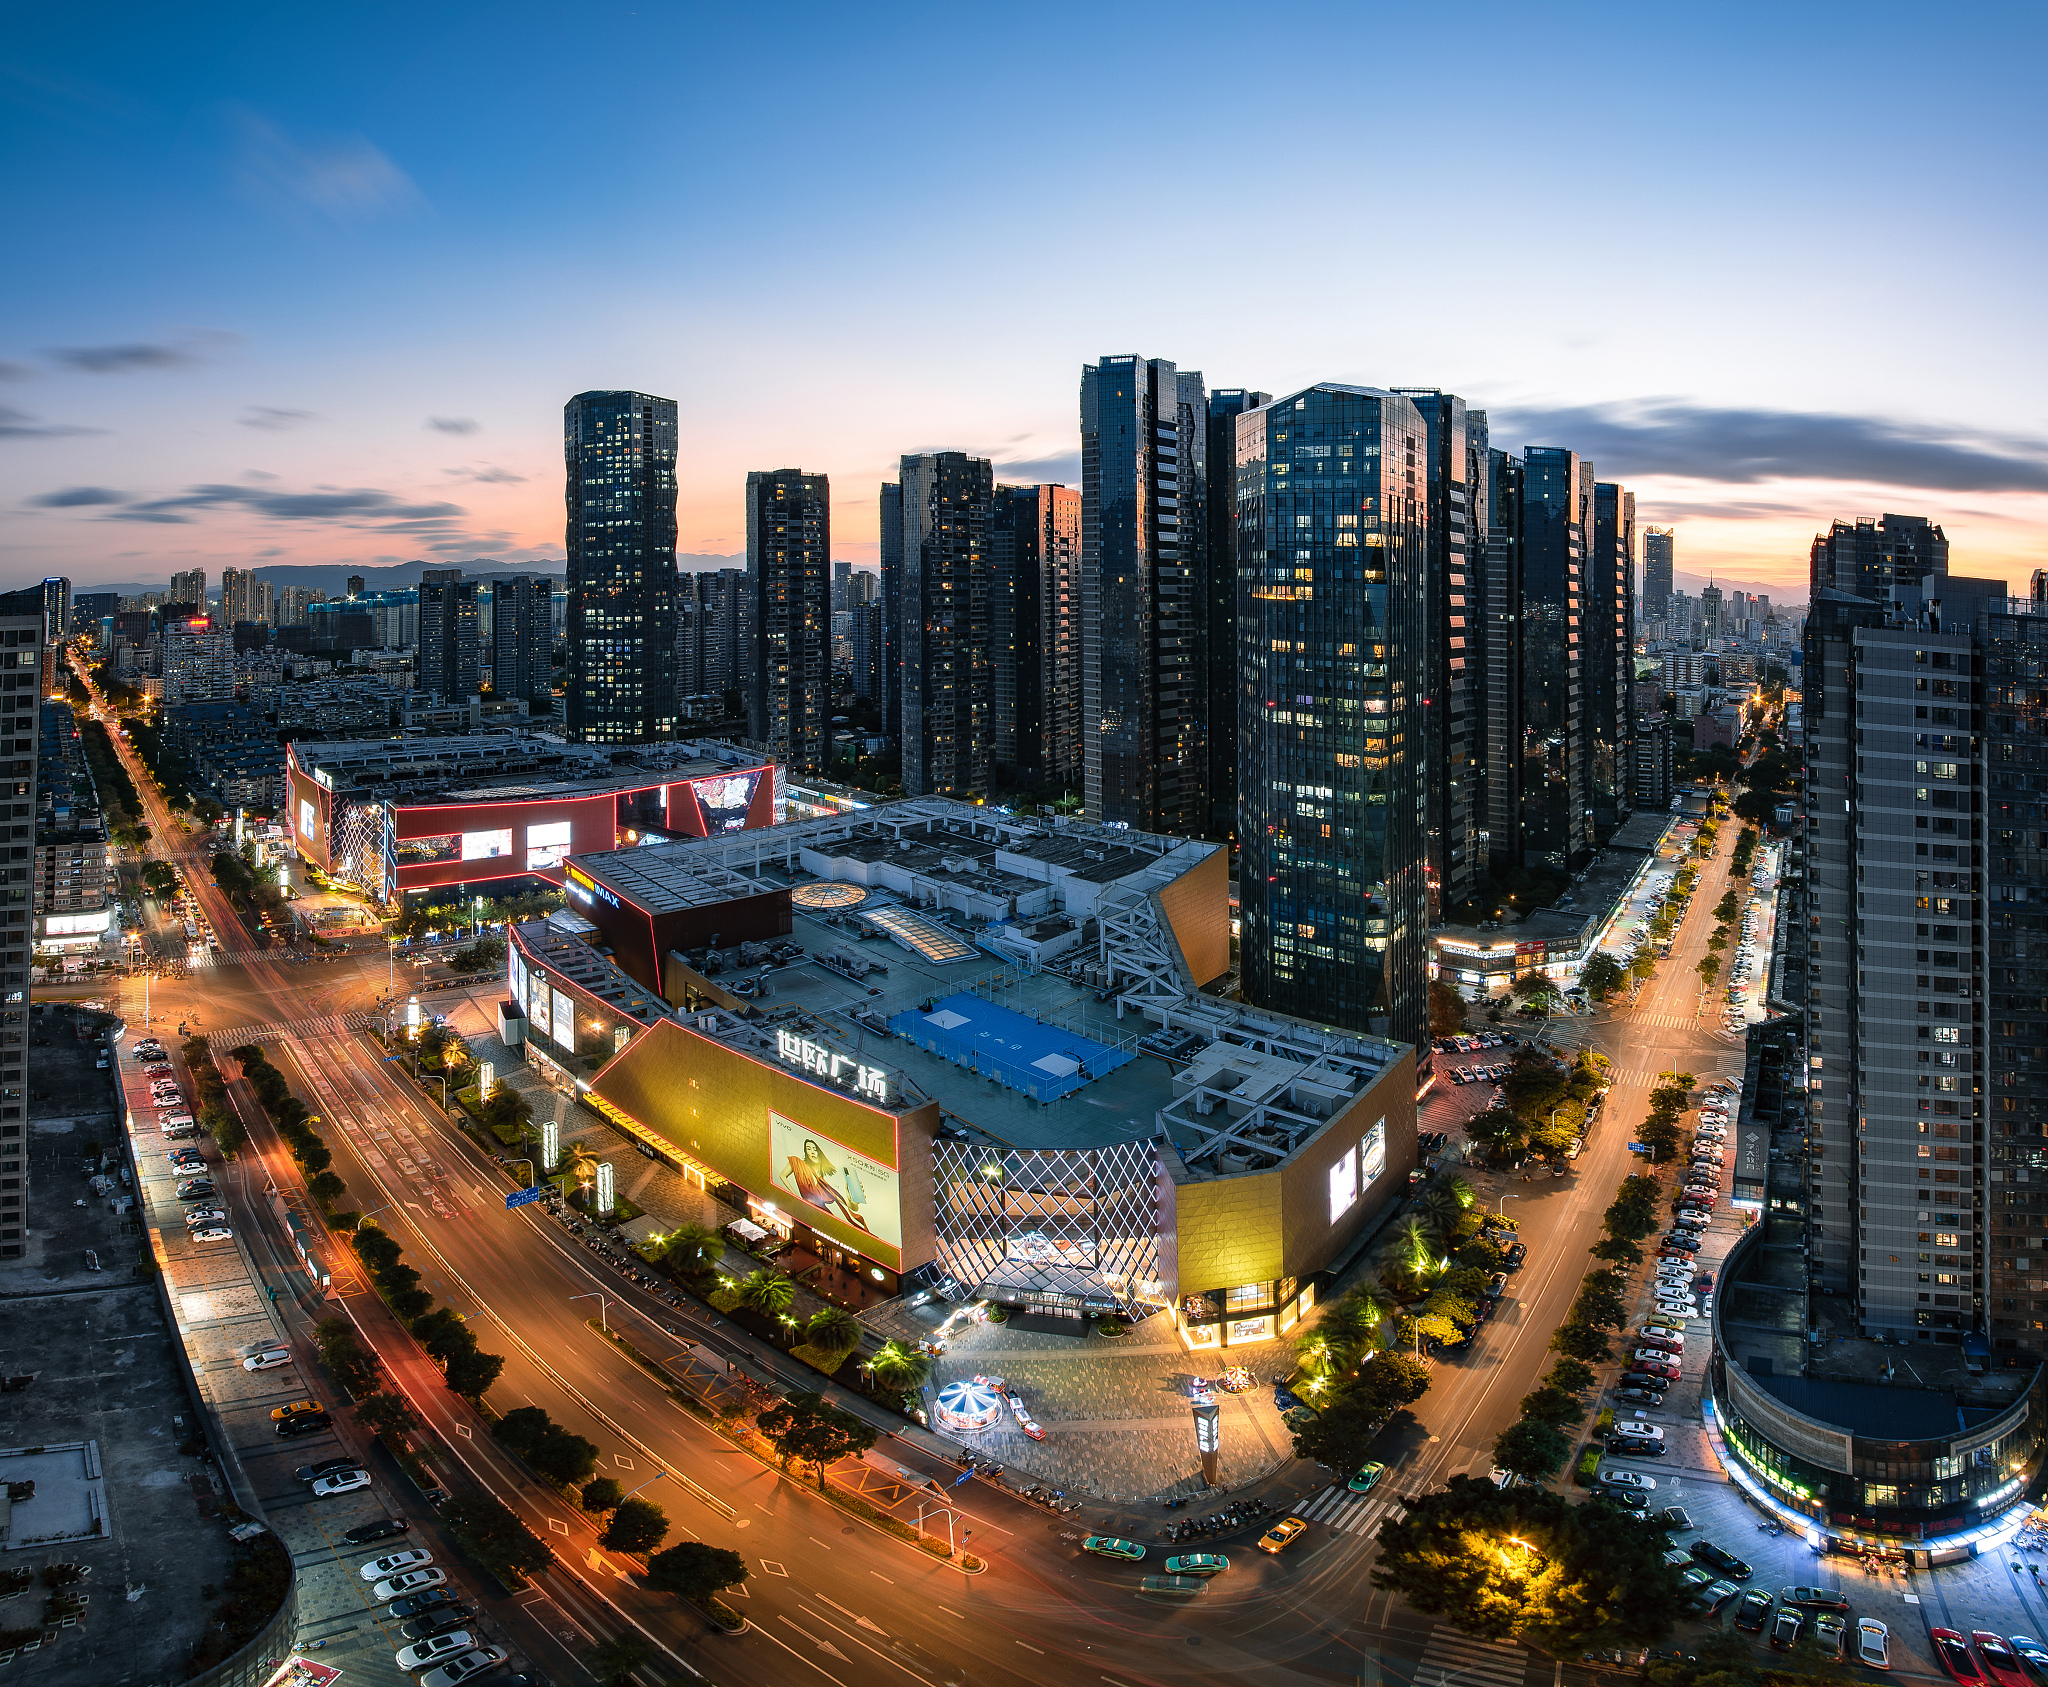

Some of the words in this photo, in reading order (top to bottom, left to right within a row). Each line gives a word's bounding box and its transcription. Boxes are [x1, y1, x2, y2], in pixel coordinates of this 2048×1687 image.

[594, 883, 620, 909] IMAX
[777, 1029, 886, 1097] 世欧广场
[837, 1077, 886, 1104] PARK
[811, 1227, 840, 1246] STARBUCKS
